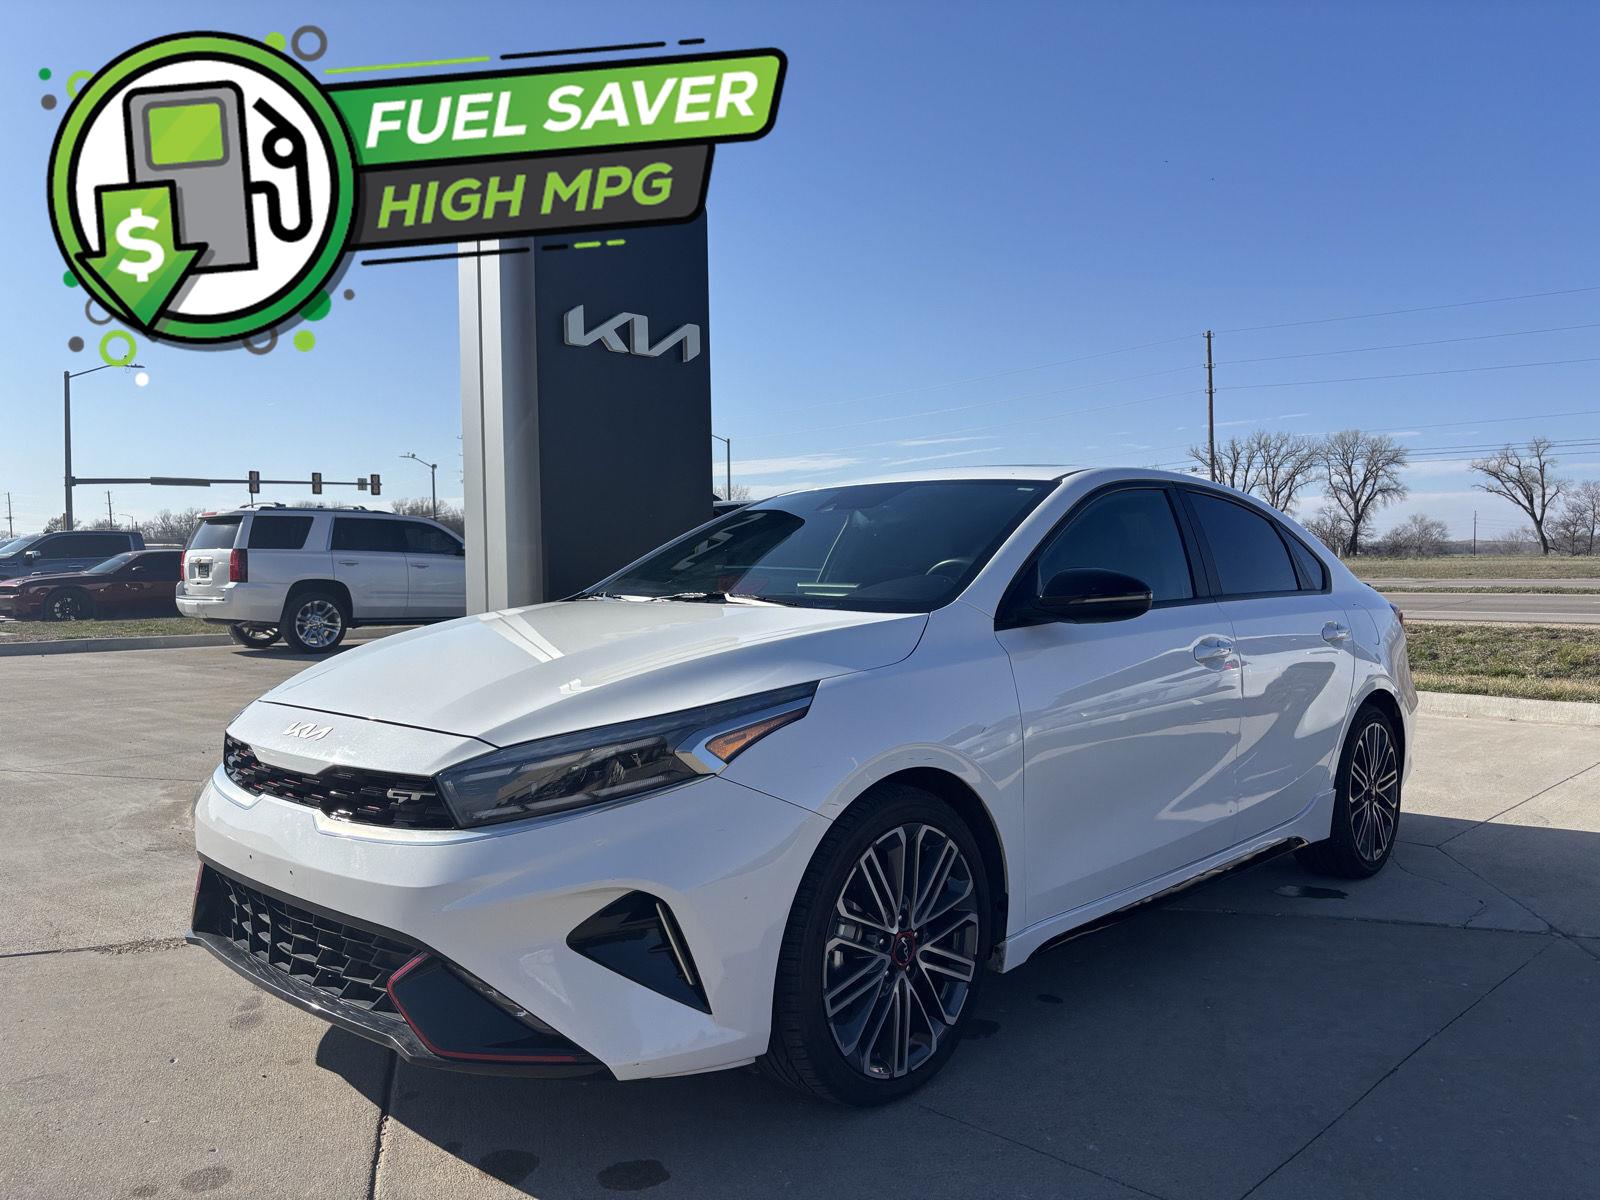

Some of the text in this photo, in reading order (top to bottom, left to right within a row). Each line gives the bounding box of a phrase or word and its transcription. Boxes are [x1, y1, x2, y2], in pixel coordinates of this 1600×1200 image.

[564, 304, 701, 363] KIA
[283, 720, 334, 741] KIA
[386, 788, 436, 806] GT
